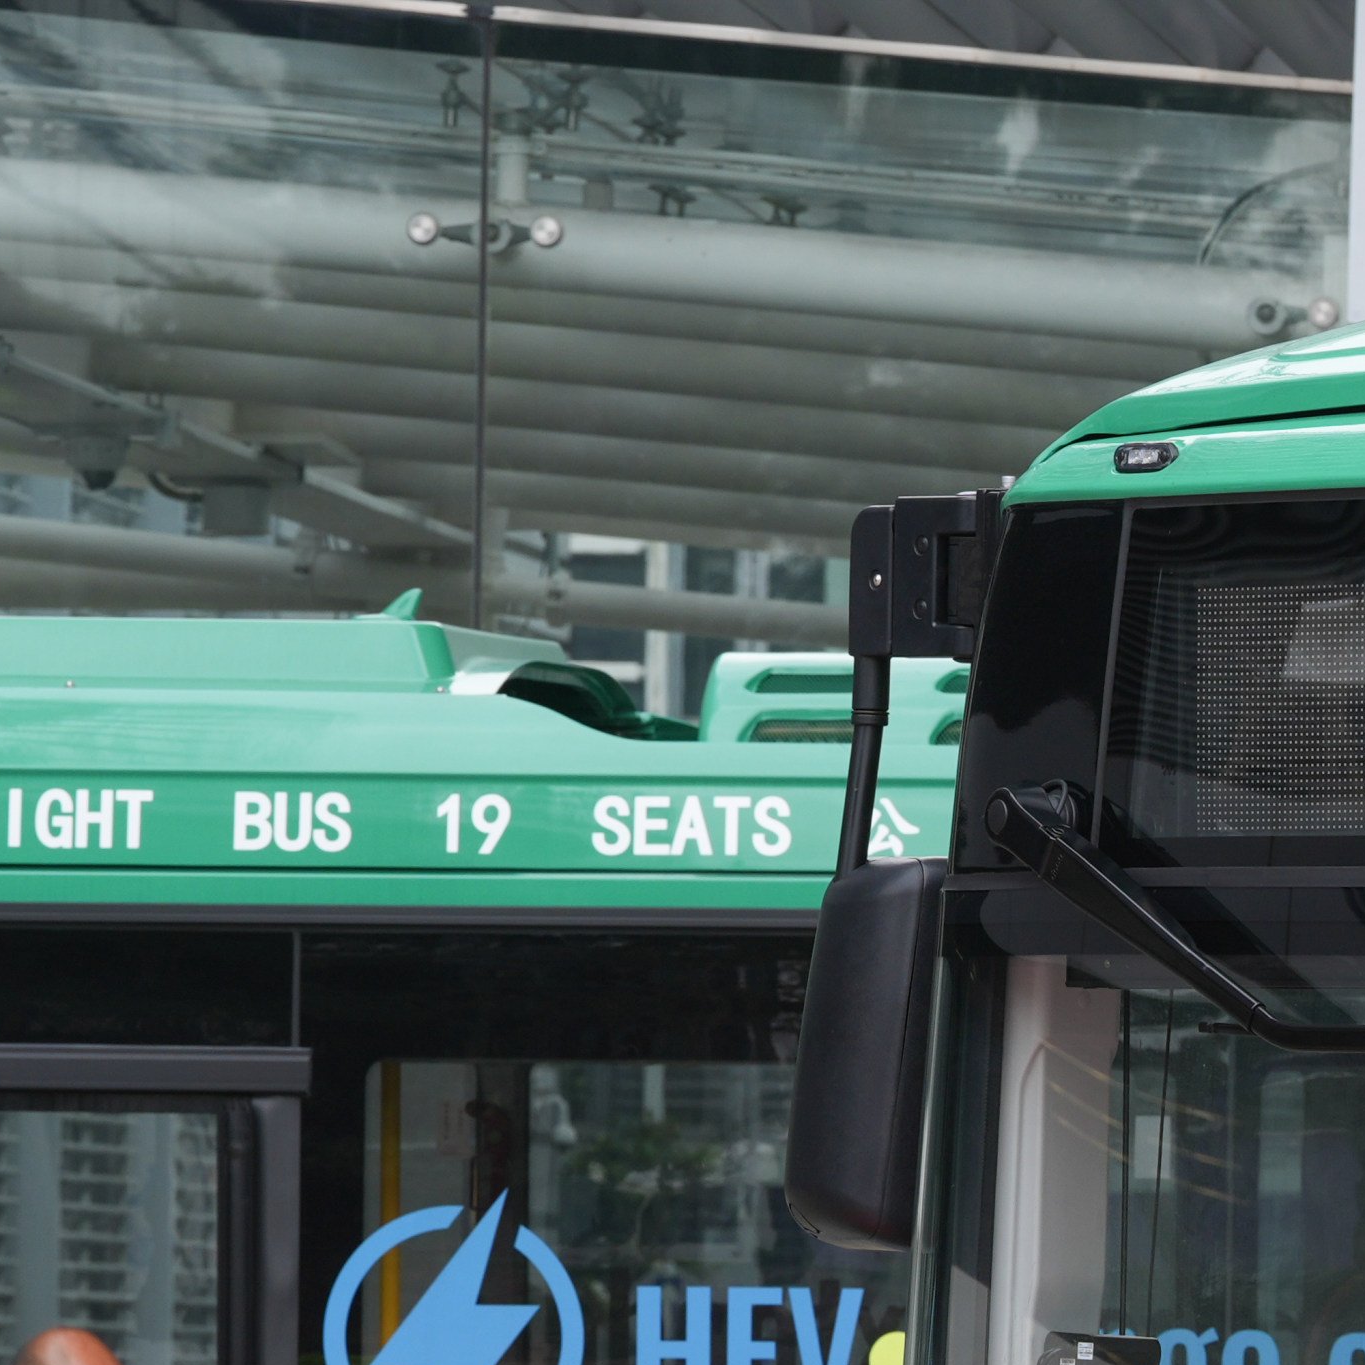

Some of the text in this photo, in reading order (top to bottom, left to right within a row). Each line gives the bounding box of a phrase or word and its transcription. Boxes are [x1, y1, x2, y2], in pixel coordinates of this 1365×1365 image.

[233, 791, 353, 852] BUS
[435, 793, 512, 854] 19
[591, 795, 792, 857] SEATS
